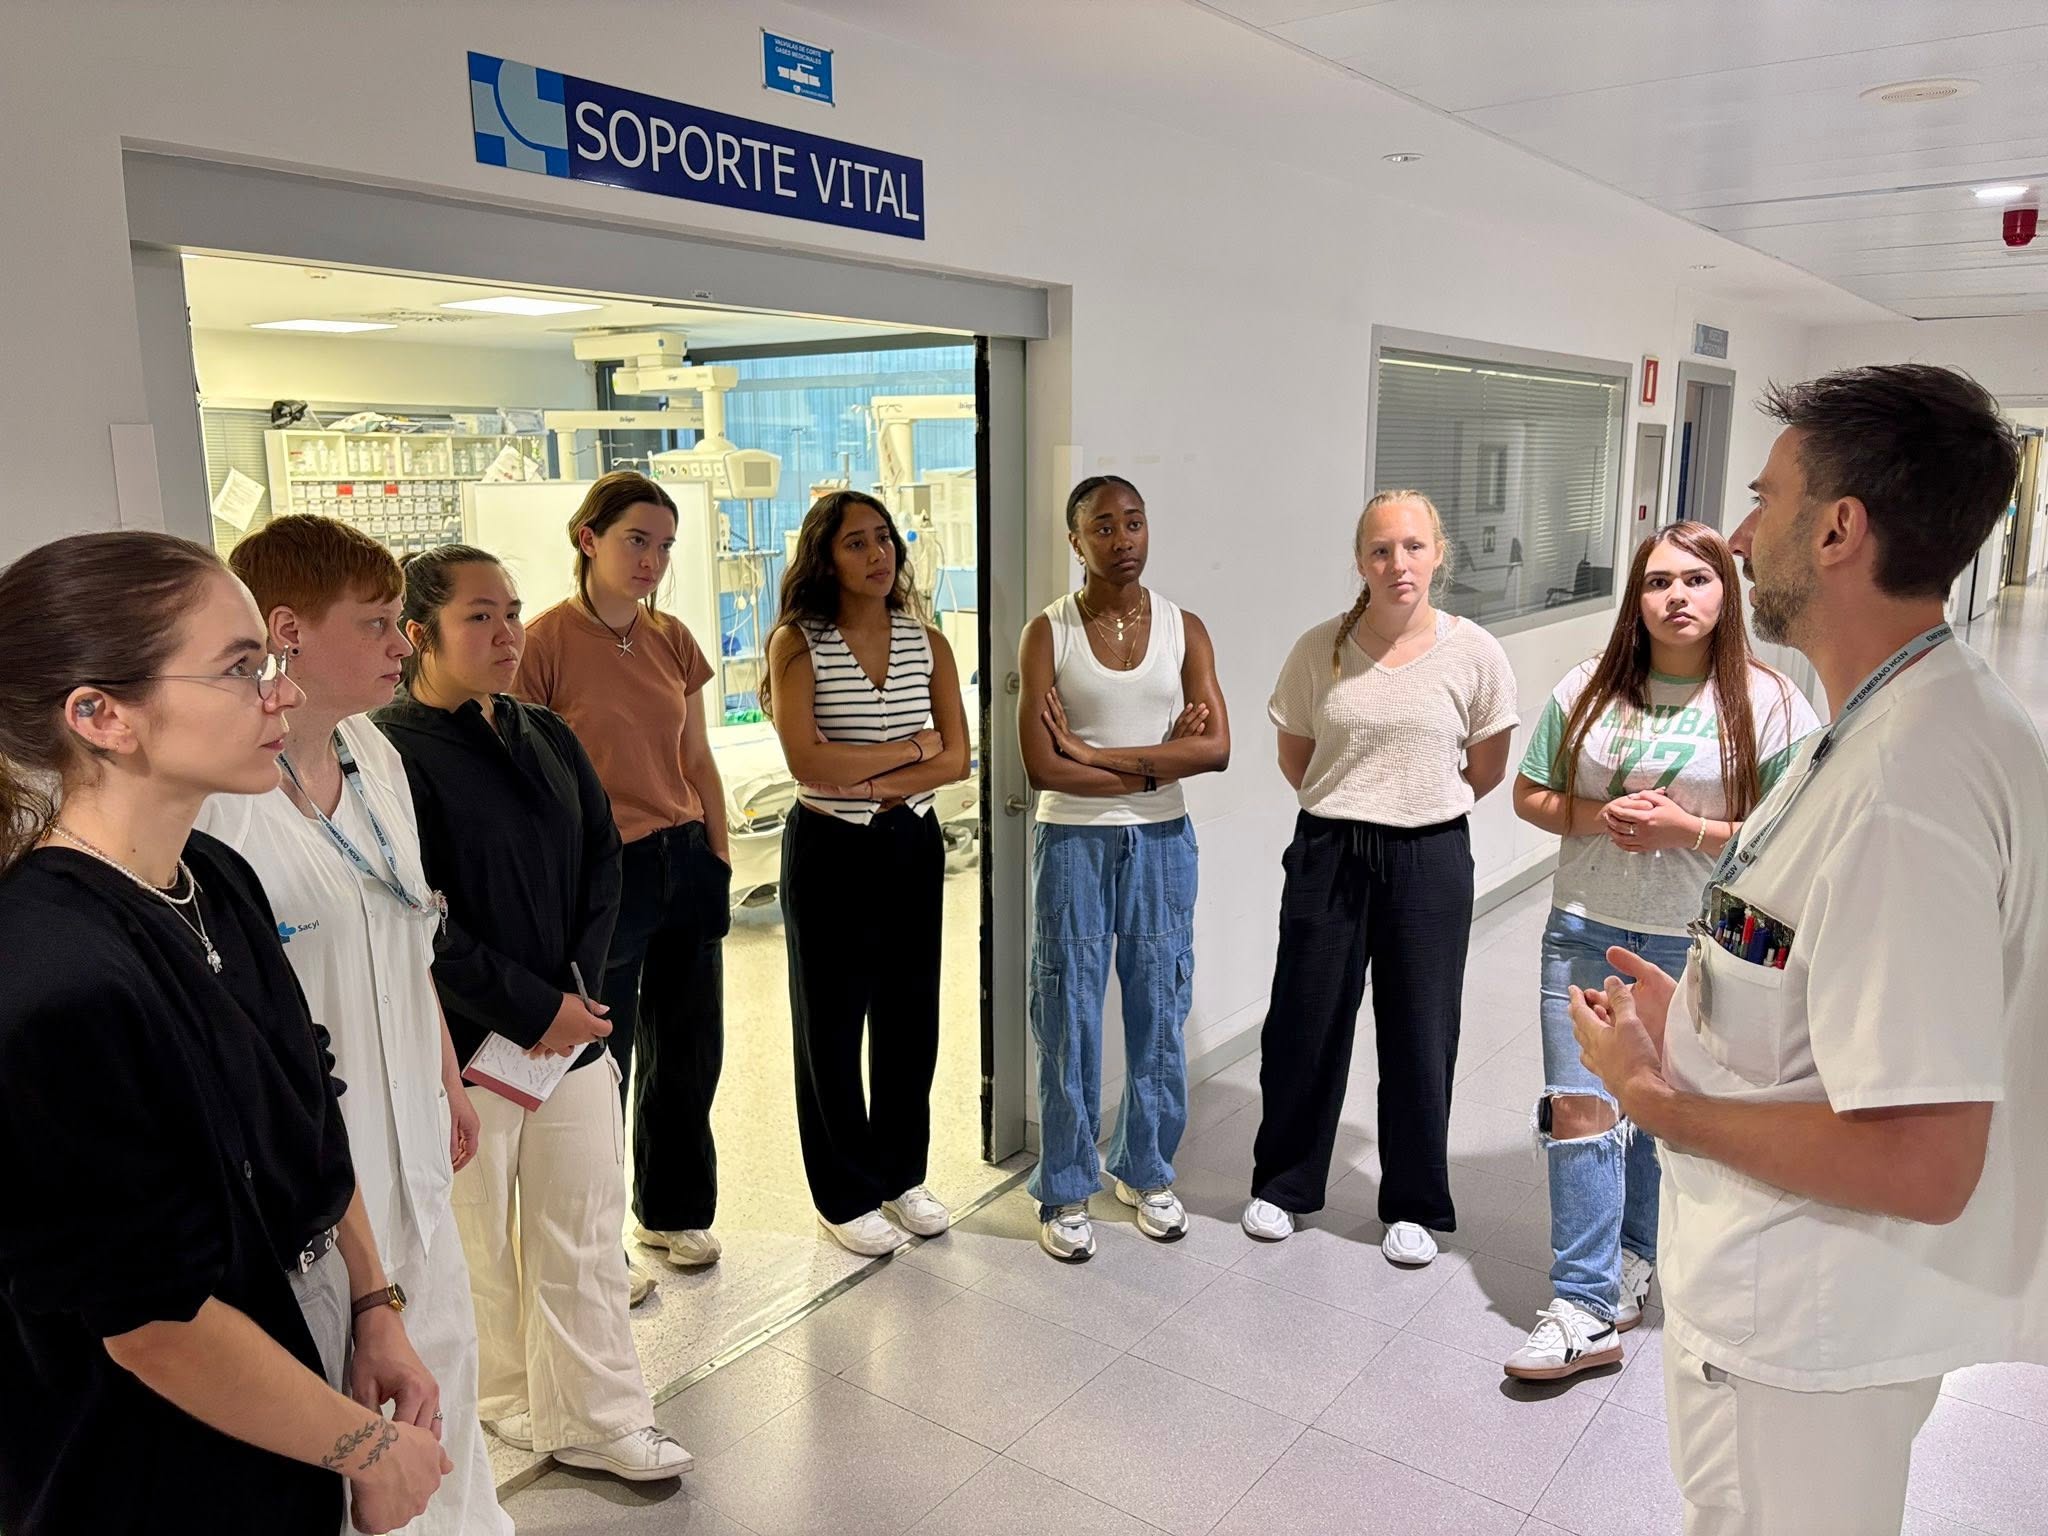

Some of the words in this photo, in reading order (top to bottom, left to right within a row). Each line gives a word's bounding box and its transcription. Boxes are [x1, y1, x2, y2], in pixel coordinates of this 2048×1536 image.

[575, 101, 798, 198] SOPORTE
[810, 153, 920, 221] VITAL
[1608, 736, 1696, 796] 77
[297, 919, 320, 932] Sacyl
